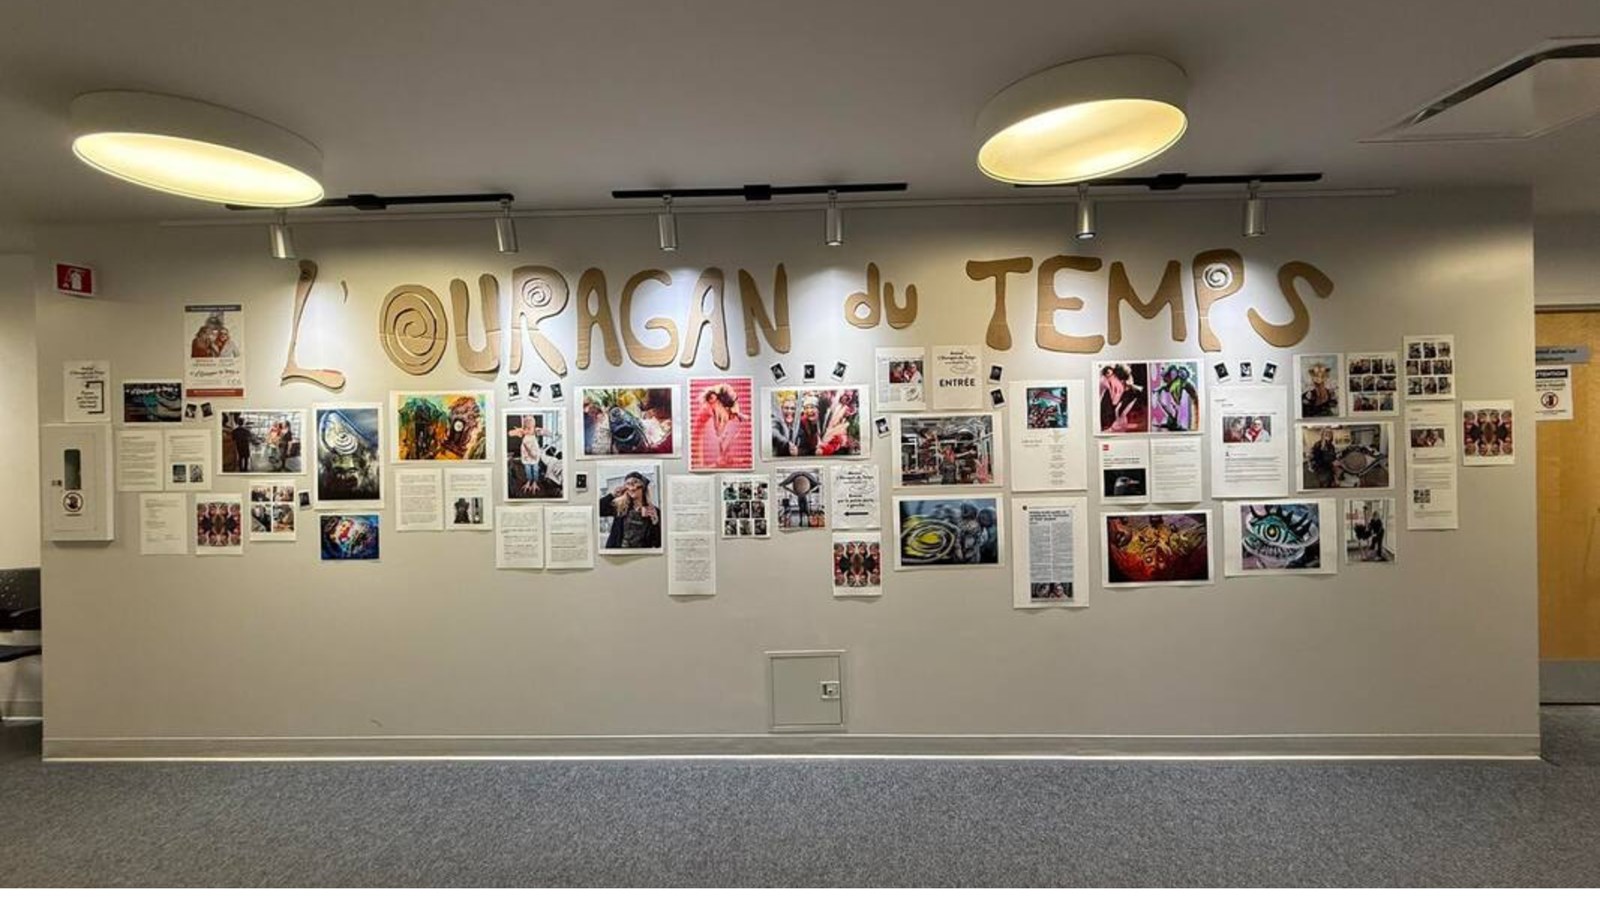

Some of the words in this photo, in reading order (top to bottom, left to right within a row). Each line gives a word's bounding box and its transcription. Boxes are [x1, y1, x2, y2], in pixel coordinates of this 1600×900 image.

[844, 262, 918, 329] du
[966, 248, 1334, 353] TEMPS
[939, 376, 976, 388] ENTRÉE
